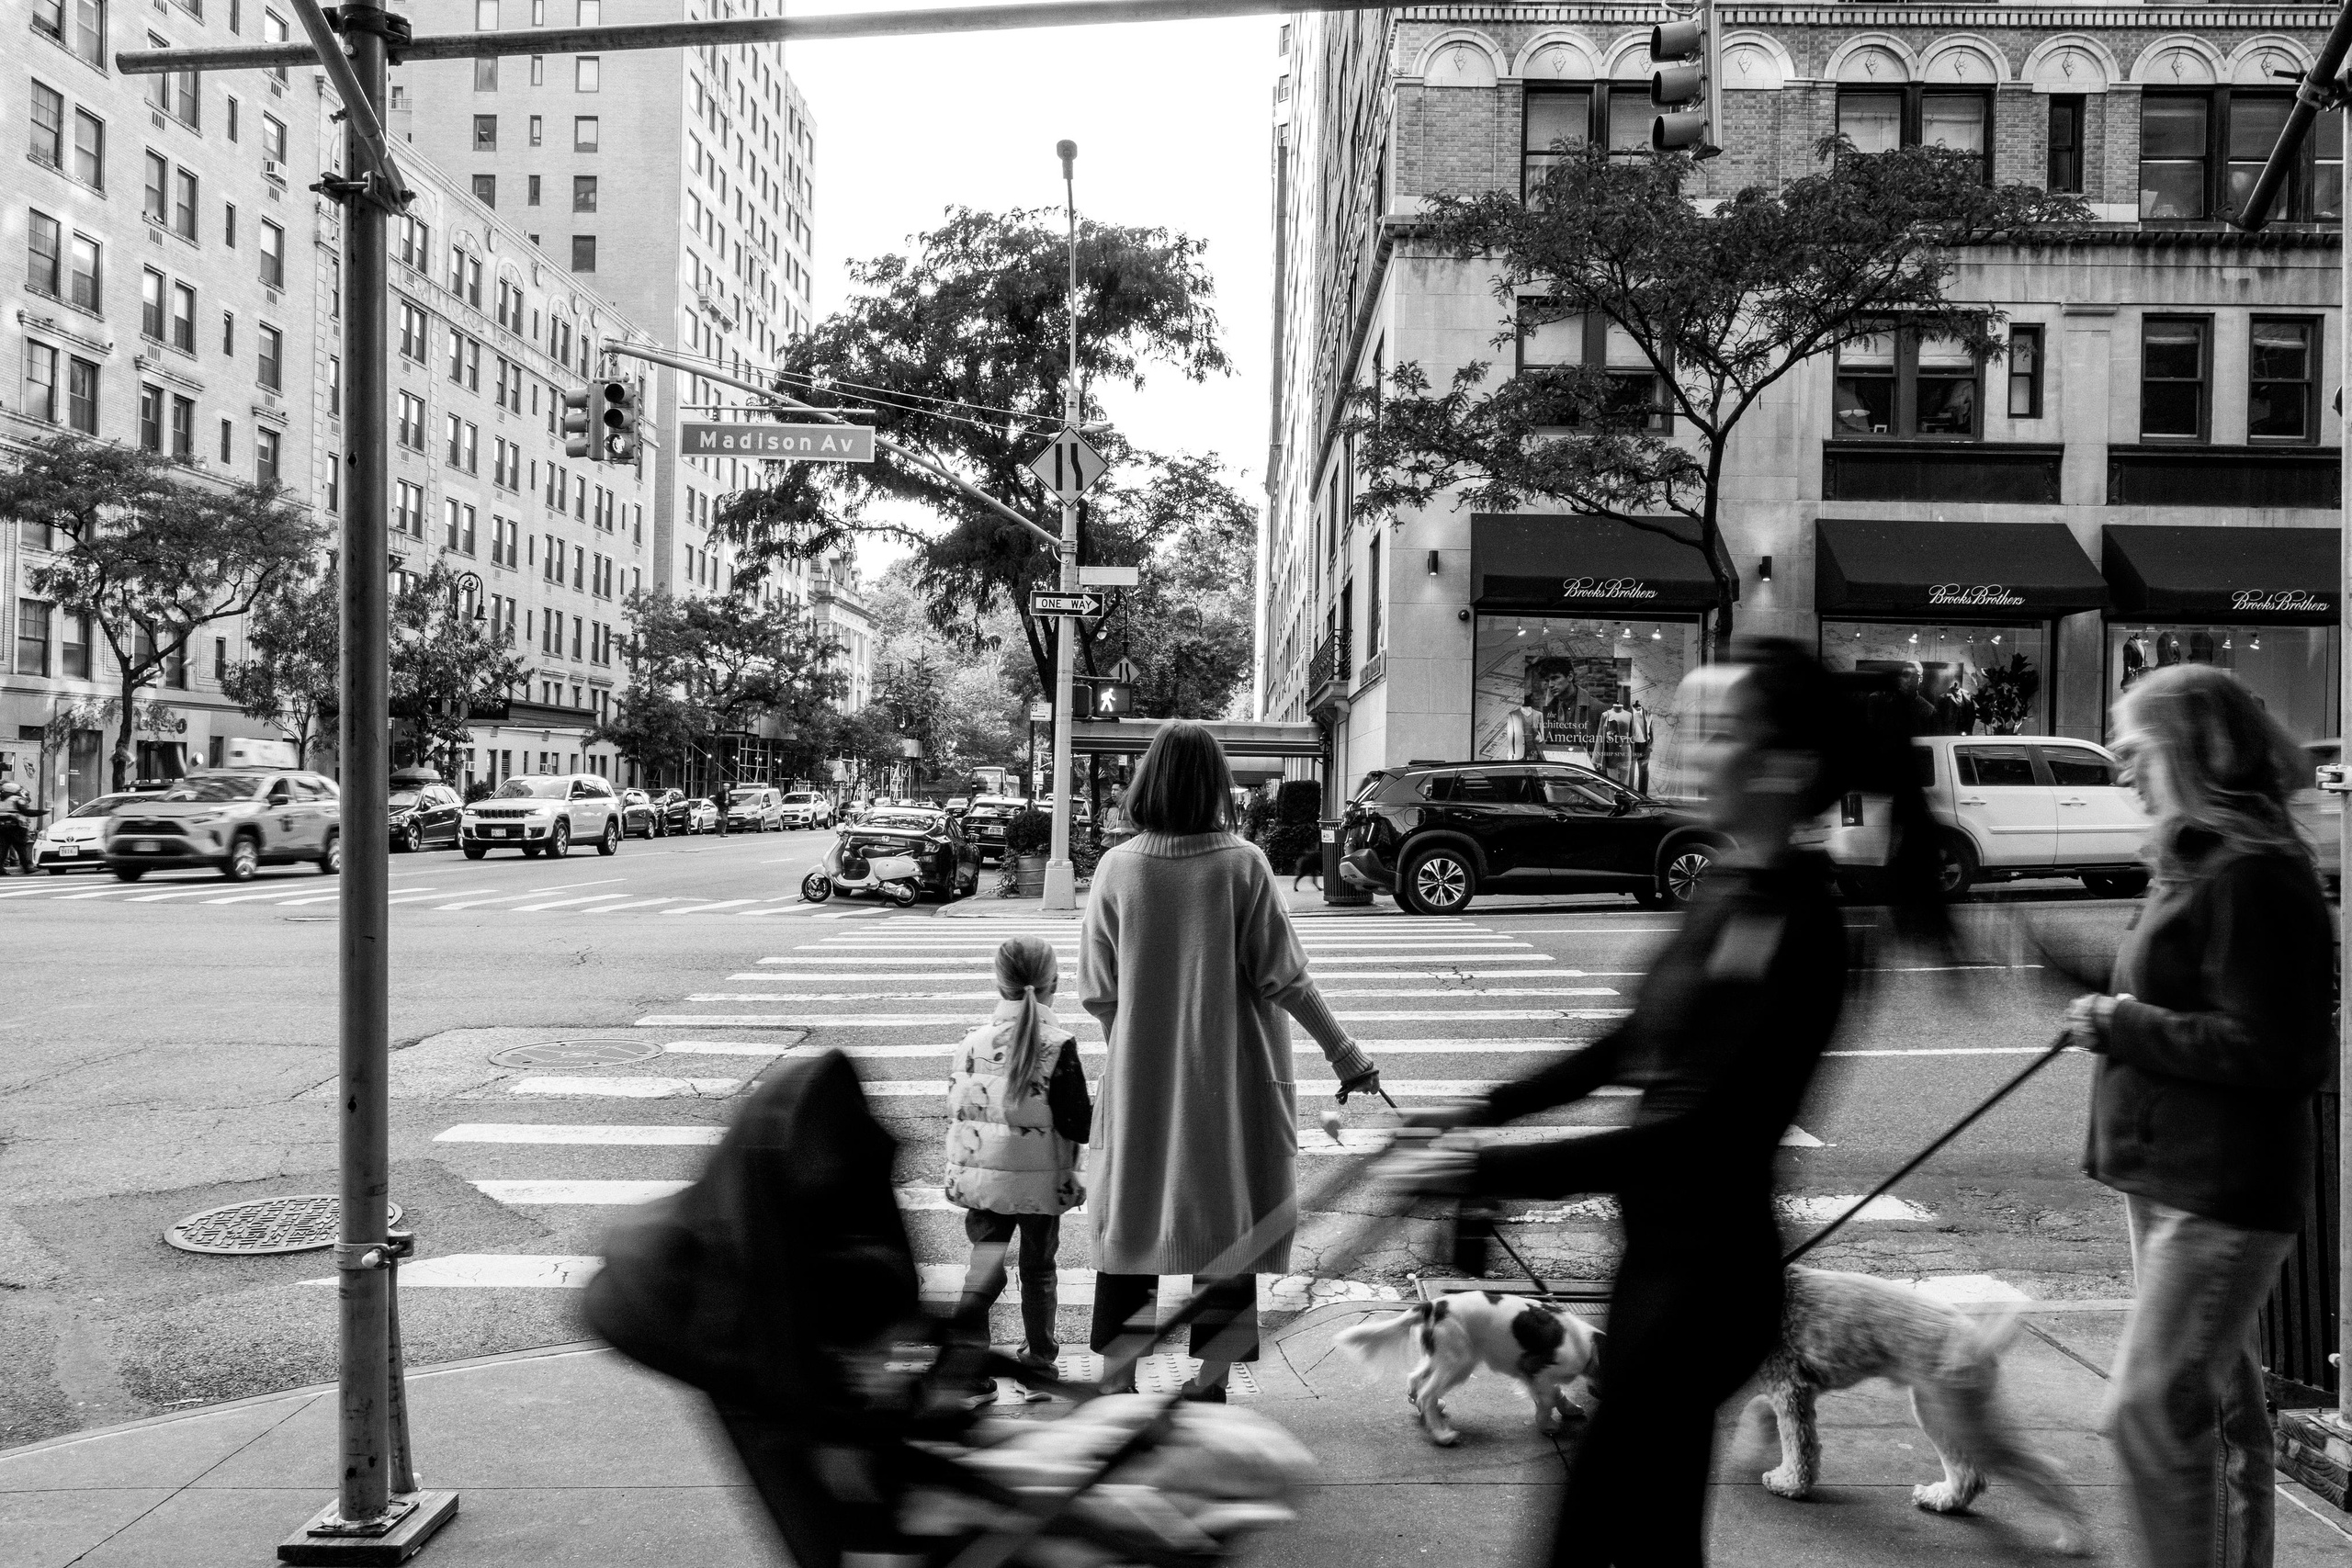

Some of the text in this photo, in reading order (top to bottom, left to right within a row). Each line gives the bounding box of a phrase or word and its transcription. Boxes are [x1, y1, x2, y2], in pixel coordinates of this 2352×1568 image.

[699, 430, 854, 452] Madison Av
[1563, 576, 1658, 599] Brooks Brothers
[1928, 583, 2026, 605] Brooks Brothers
[1041, 599, 1092, 609] ONE WAY
[2232, 589, 2330, 611] Brooks Brothers
[1577, 720, 1589, 729] of
[1544, 731, 1604, 743] American
[222, 1232, 266, 1240] MADE
[290, 1229, 331, 1237] INDIA
